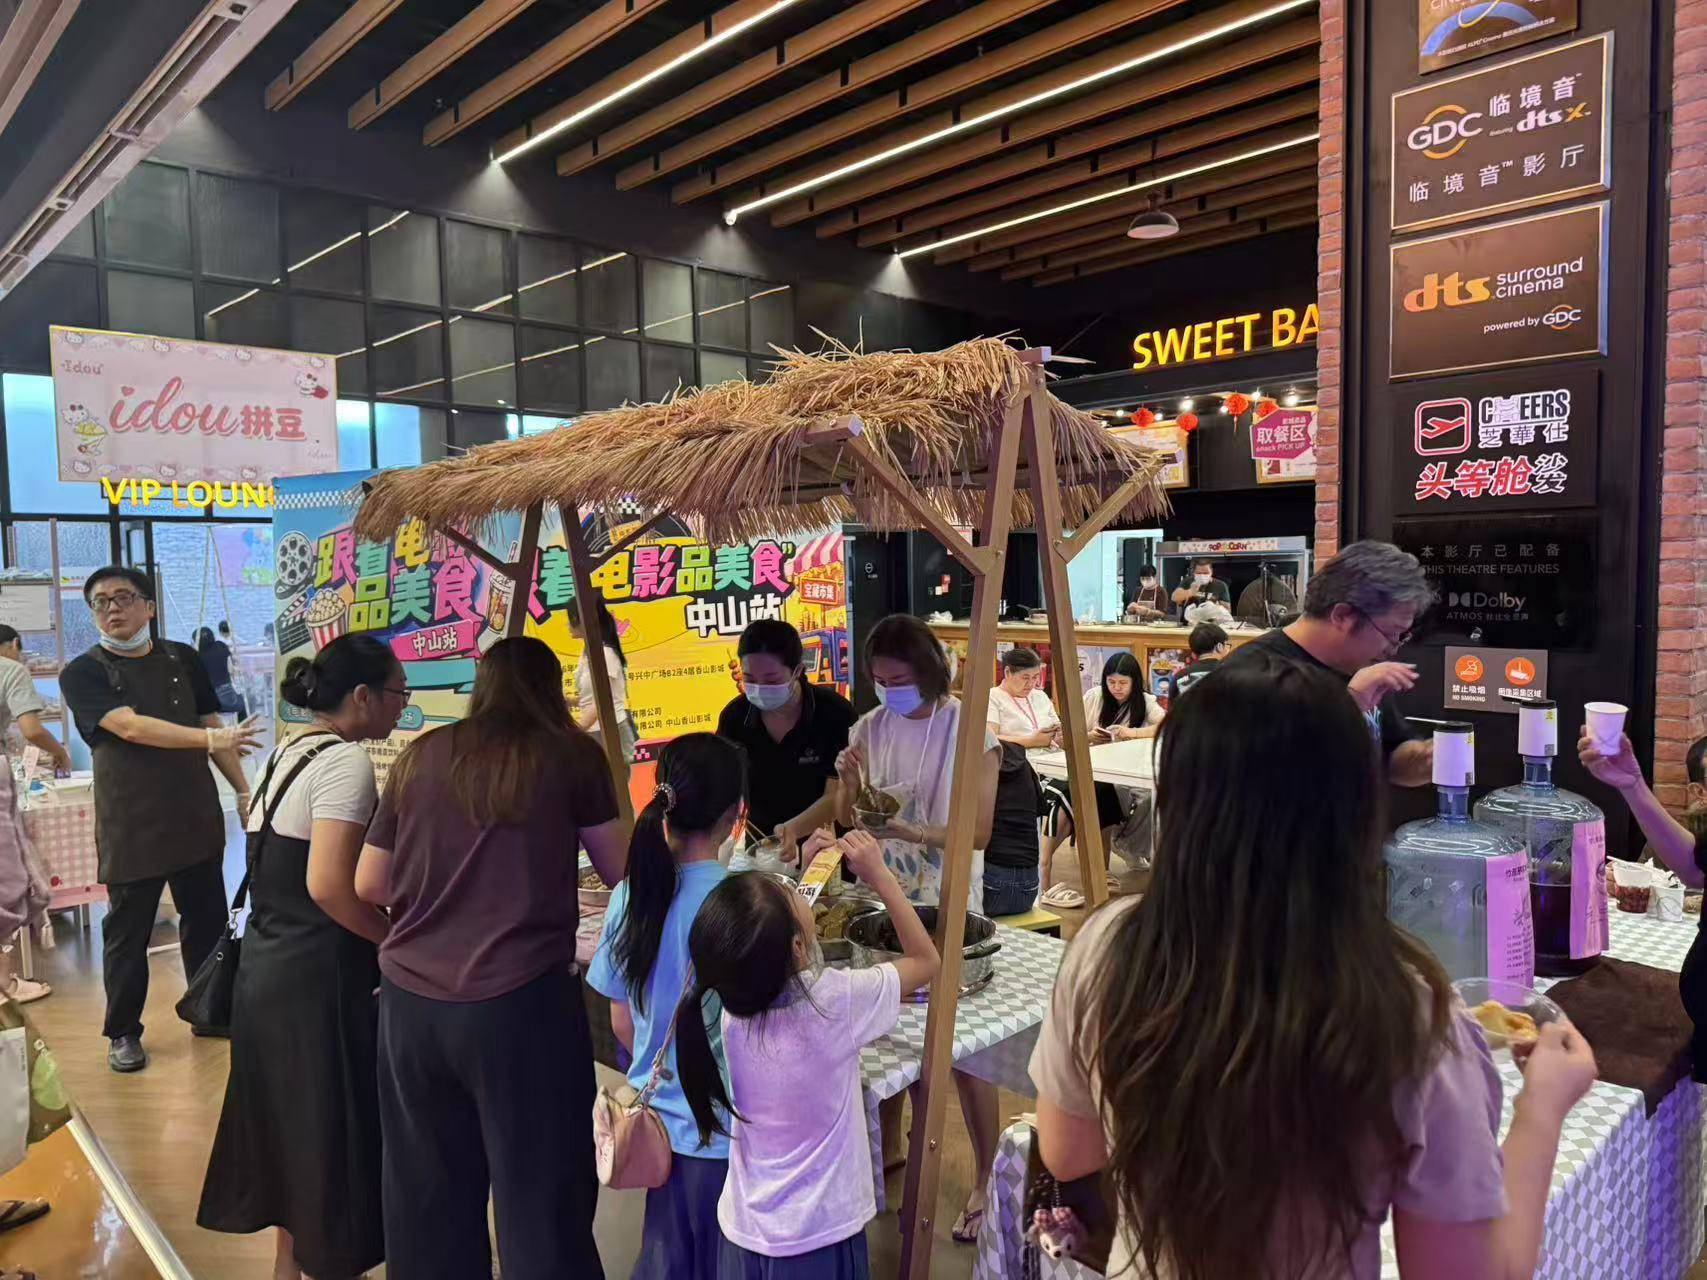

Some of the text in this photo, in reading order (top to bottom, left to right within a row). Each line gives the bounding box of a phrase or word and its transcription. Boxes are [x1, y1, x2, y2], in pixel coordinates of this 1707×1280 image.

[1407, 112, 1483, 150] GDC
[1496, 256, 1584, 285] surround
[1403, 271, 1491, 312] dts
[1495, 276, 1565, 299] cinema
[1483, 308, 1582, 334] powered by GDC
[1132, 312, 1262, 370] SWEET
[109, 376, 240, 438] idou
[241, 404, 307, 442] 拼豆
[1257, 424, 1307, 444] 取餐区
[101, 477, 162, 506] VIP
[1421, 543, 1560, 559] 本影厅已配备
[1448, 564, 1497, 575] THEATRE
[1500, 562, 1560, 575] FEATURES
[349, 552, 484, 632] 品美食
[1473, 591, 1527, 611] Dolby
[1446, 611, 1483, 621] ATMOS
[411, 628, 459, 657] 中山站
